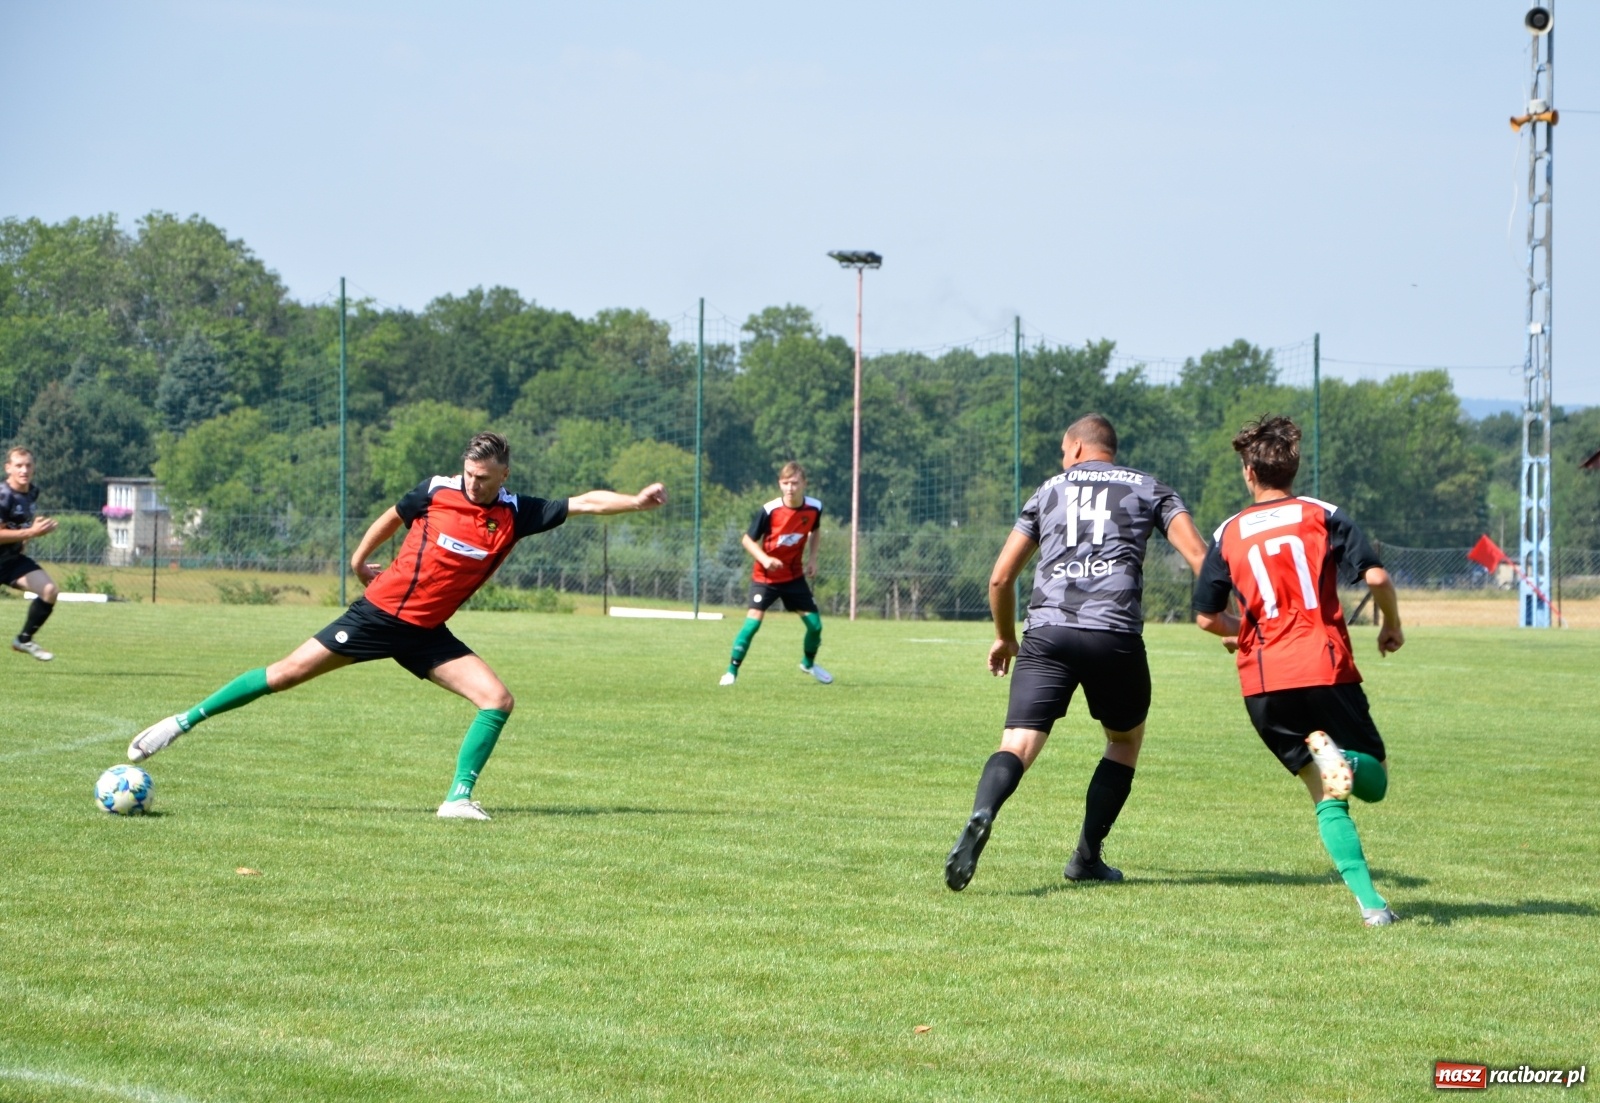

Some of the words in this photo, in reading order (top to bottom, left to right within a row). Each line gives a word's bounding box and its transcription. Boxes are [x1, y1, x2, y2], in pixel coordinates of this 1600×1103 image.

[1067, 470, 1144, 485] OWSISZCZE
[1064, 486, 1112, 547] 14
[1051, 553, 1117, 579] safer
[1247, 534, 1318, 619] 17
